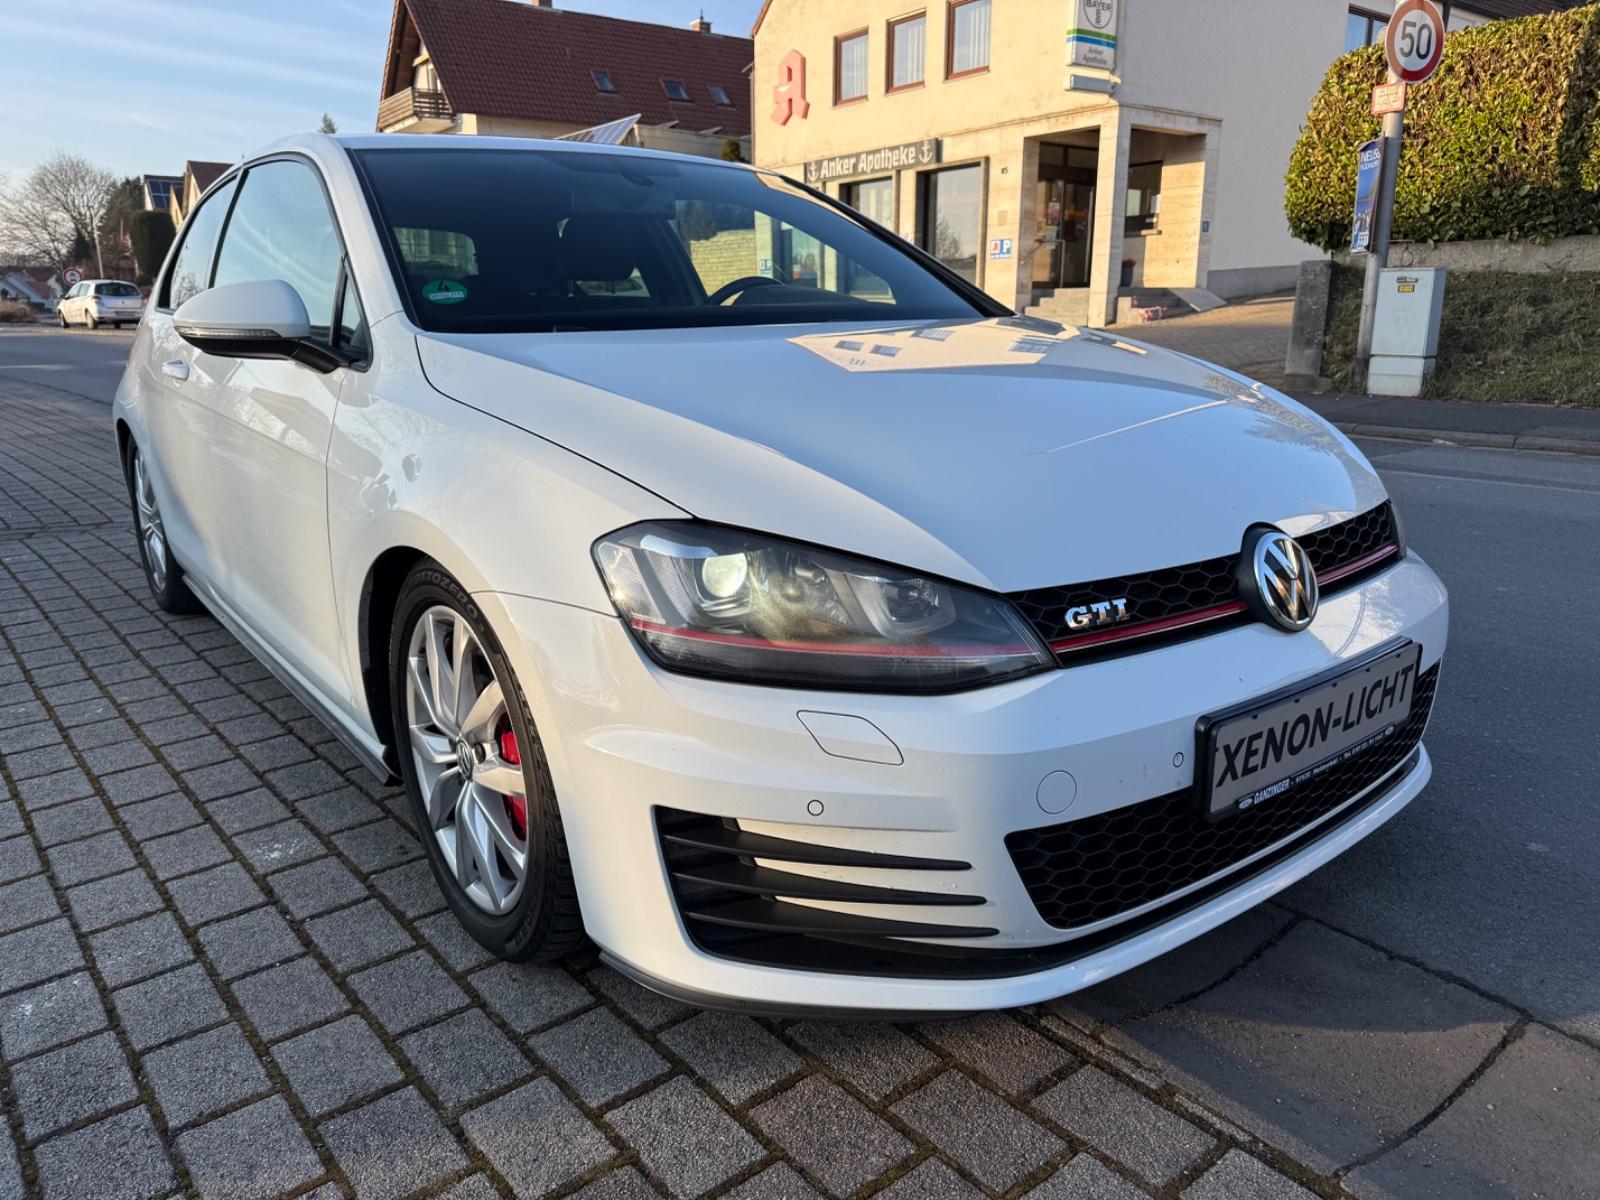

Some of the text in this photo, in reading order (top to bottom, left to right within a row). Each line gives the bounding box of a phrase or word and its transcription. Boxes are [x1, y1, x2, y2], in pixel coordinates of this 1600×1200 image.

[1400, 20, 1432, 60] 50
[770, 48, 810, 126] A
[820, 145, 916, 179] Anker Apotheke
[1065, 598, 1129, 630] GTI
[1216, 664, 1414, 788] XENON-LICHT
[1254, 778, 1290, 805] GANZINGER
